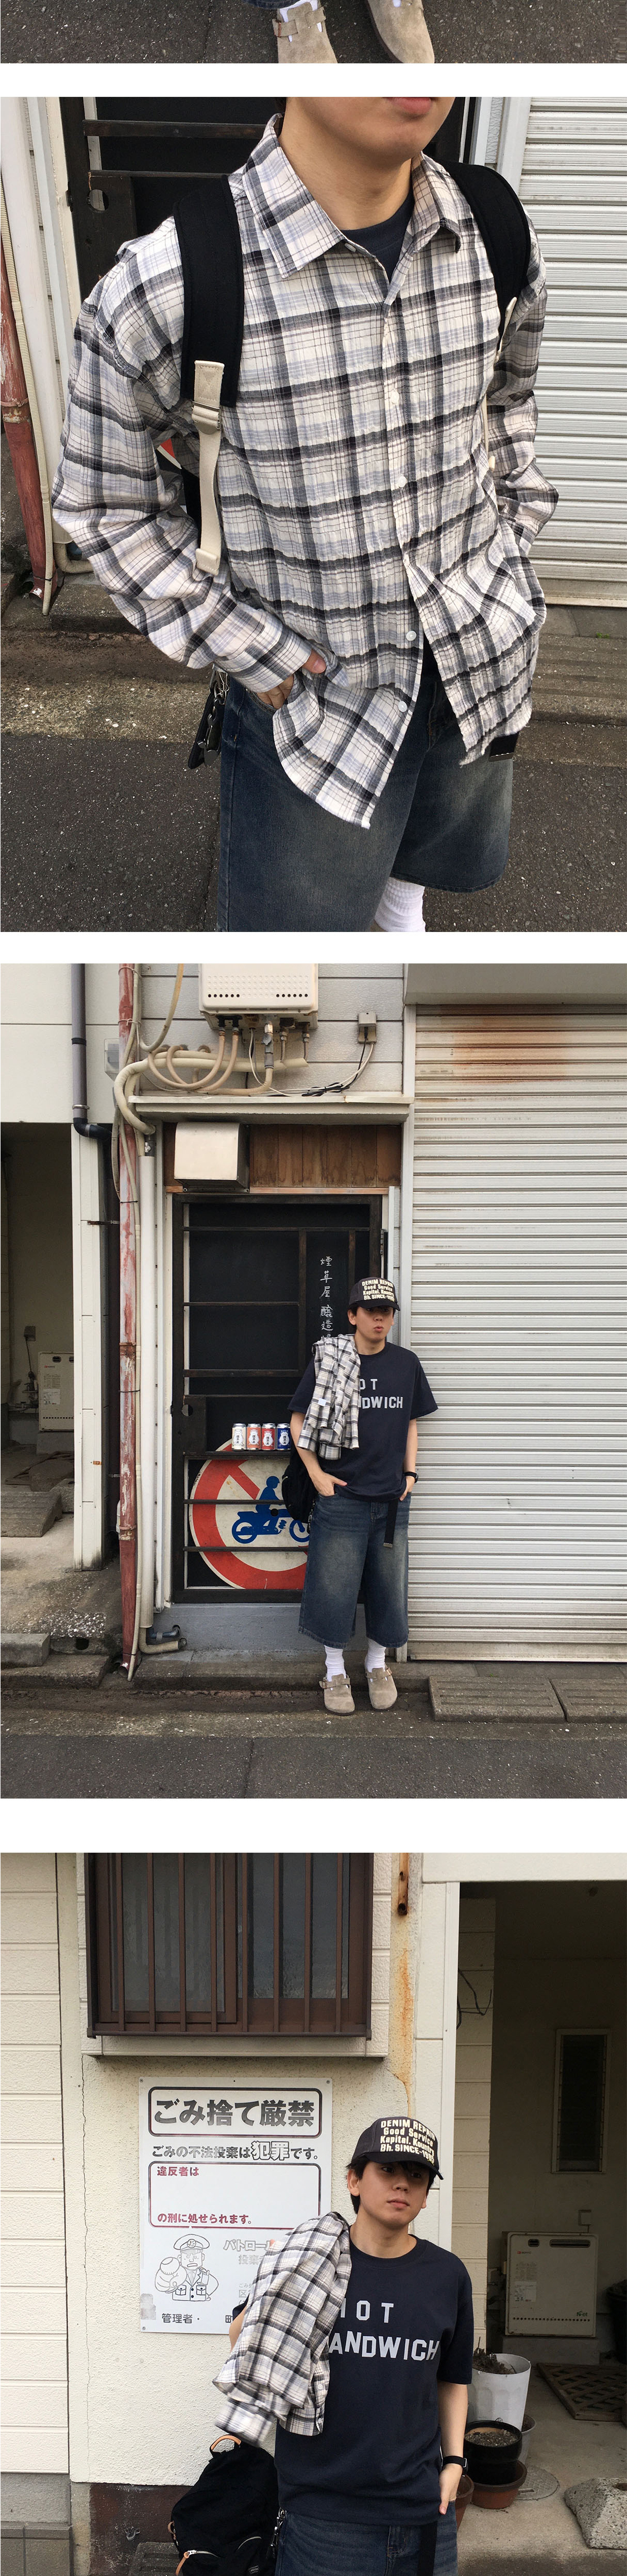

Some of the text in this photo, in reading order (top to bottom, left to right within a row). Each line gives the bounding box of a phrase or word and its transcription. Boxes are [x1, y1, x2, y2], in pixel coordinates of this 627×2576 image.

[320, 1256, 333, 1298] 煙草屋
[155, 2098, 314, 2127] ごみ捨て厳禁
[381, 2120, 435, 2141] DENIM REPAIR
[383, 2127, 433, 2147] Good Service
[152, 2141, 318, 2161] ごみの不法投棄は犯罪です。
[380, 2136, 434, 2157] Kapital. Kountry
[380, 2144, 393, 2152] Bh.
[157, 2166, 199, 2177] 違反者は
[157, 2213, 251, 2225] の刑に処せられます。
